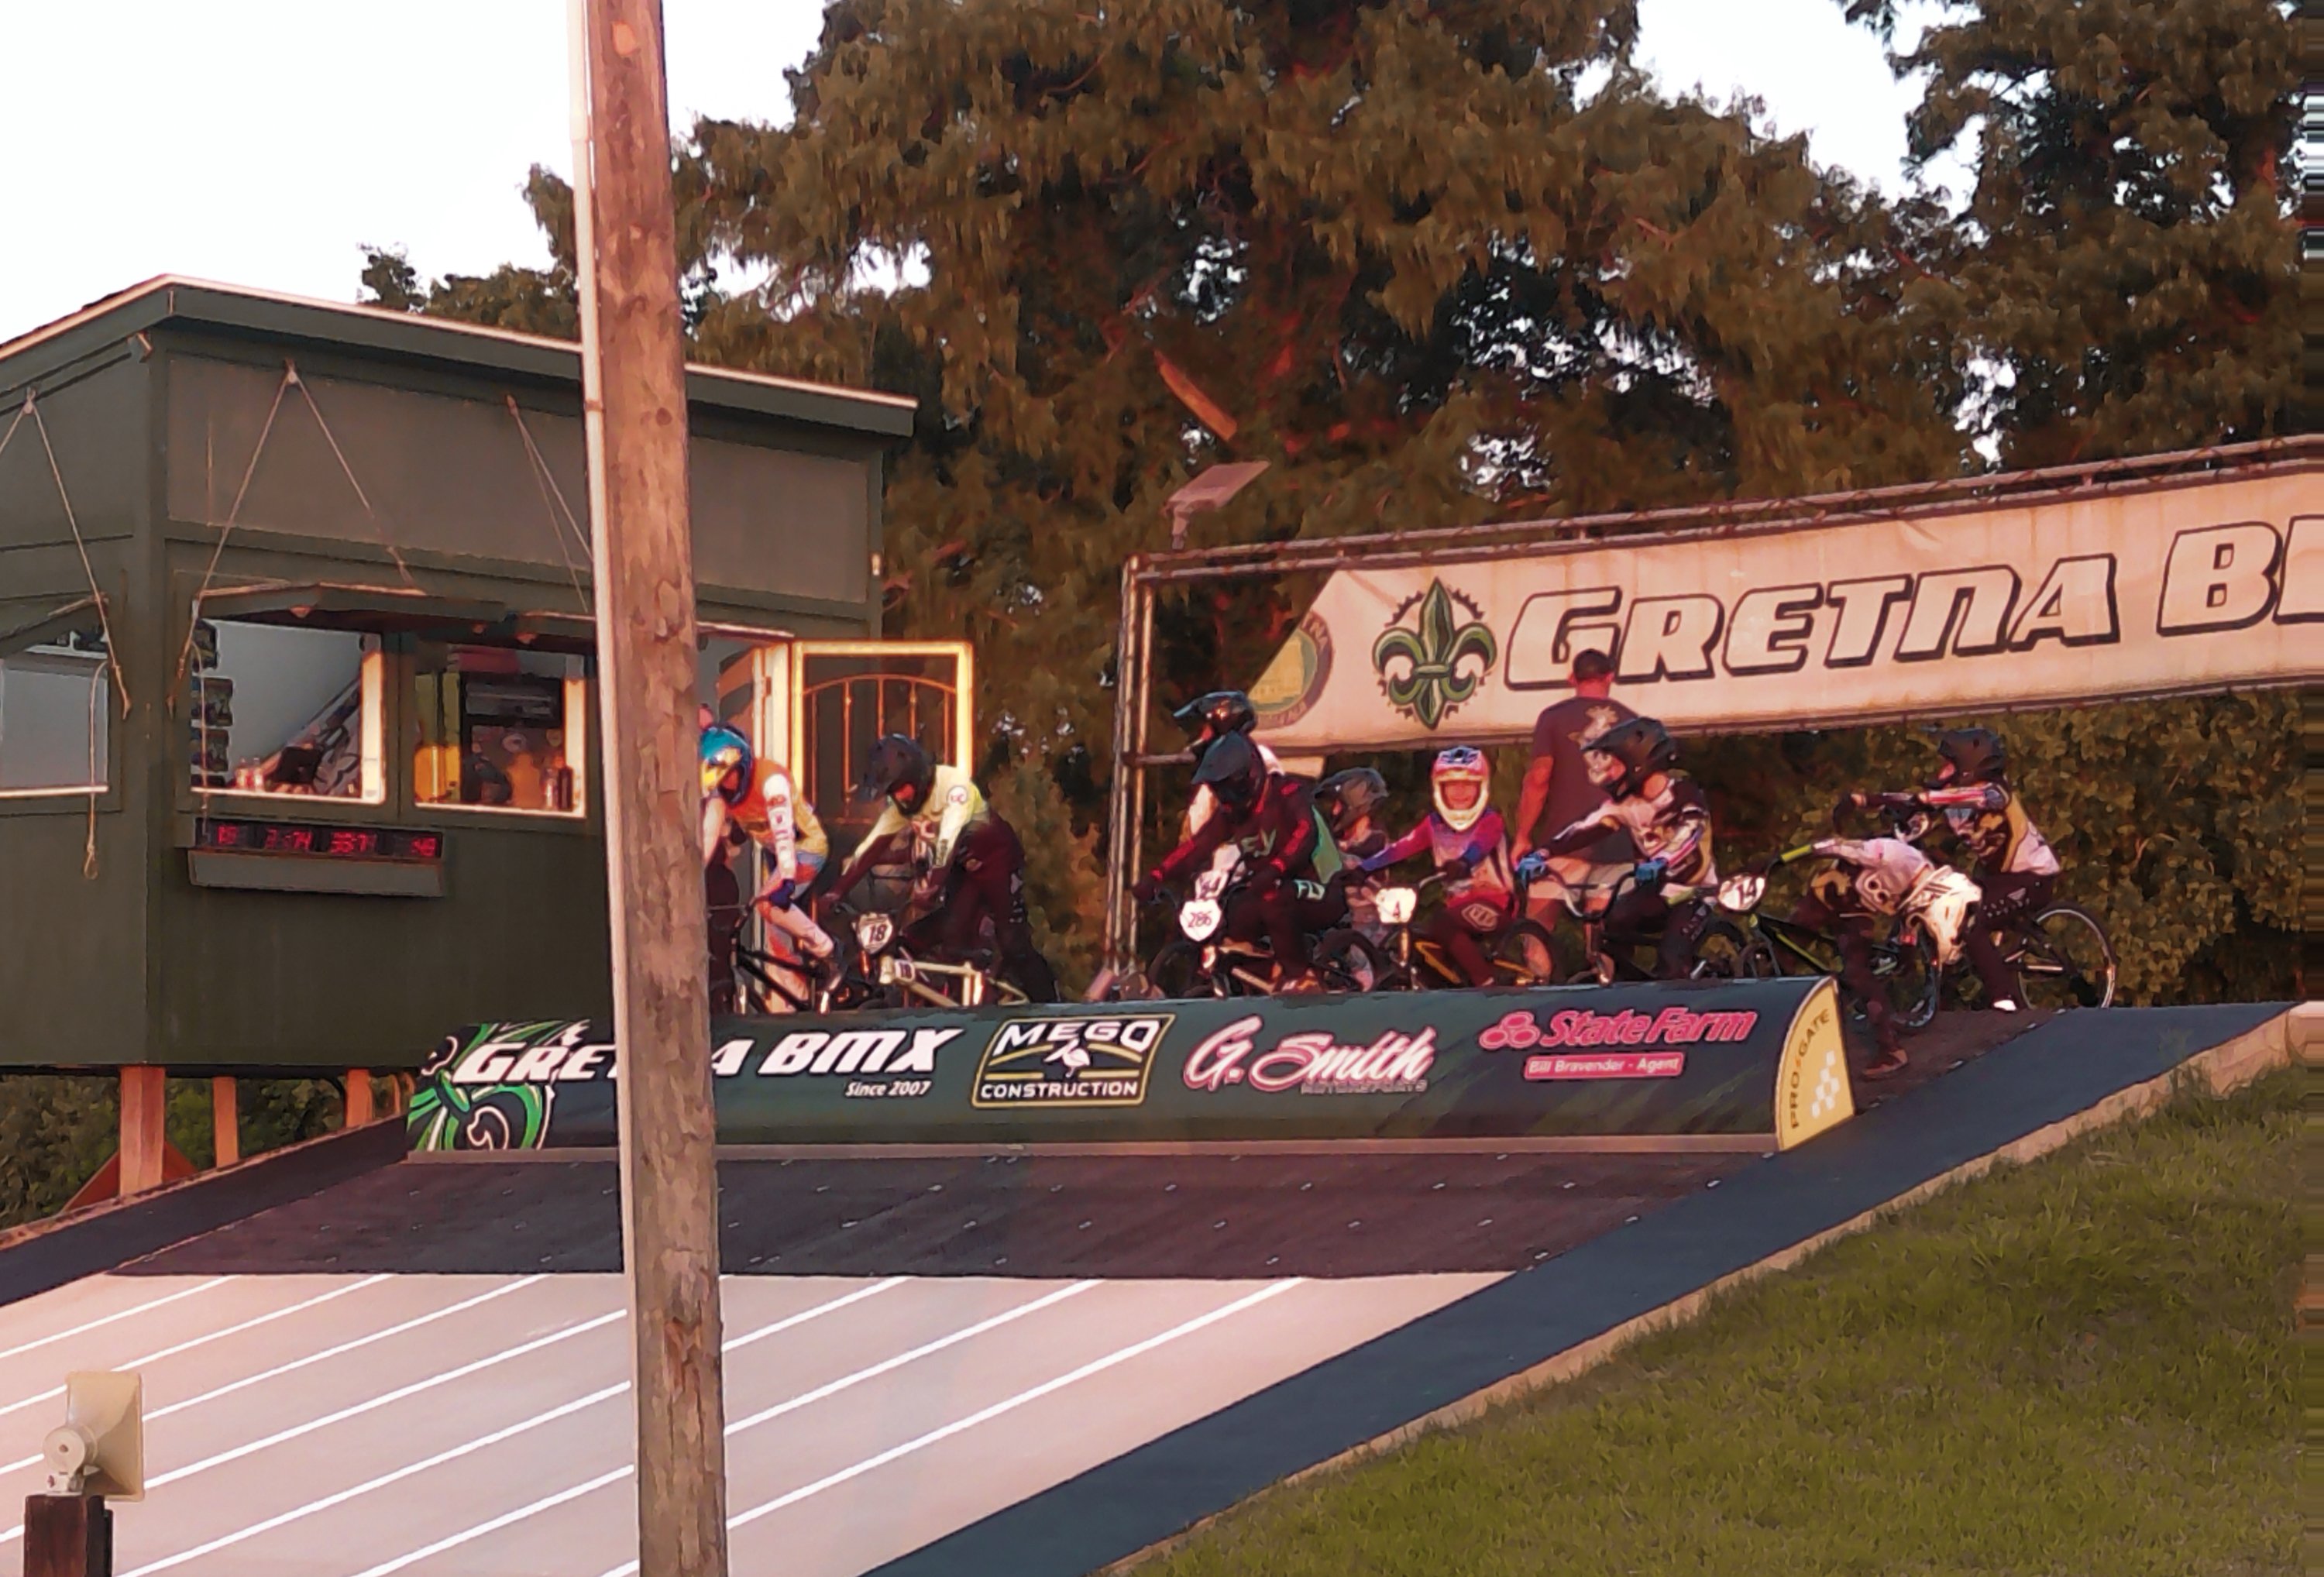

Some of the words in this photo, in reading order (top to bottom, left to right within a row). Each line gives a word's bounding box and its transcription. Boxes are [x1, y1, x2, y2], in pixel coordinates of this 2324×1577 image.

[1504, 553, 2120, 691] GRETNA
[2156, 514, 2324, 637] B
[1736, 877, 1757, 905] 14
[868, 924, 889, 942] 18
[992, 1019, 1160, 1057] MEGO
[1540, 1008, 1652, 1047] State
[1645, 1007, 1758, 1044] Farm
[452, 1039, 754, 1083] GREA
[757, 1028, 964, 1077] BMX
[1183, 1013, 1266, 1091] G.
[1249, 1026, 1439, 1094] Smith
[845, 1082, 887, 1097] Since
[888, 1081, 932, 1096] 2007
[981, 1081, 1138, 1099] CONSTRUCTION
